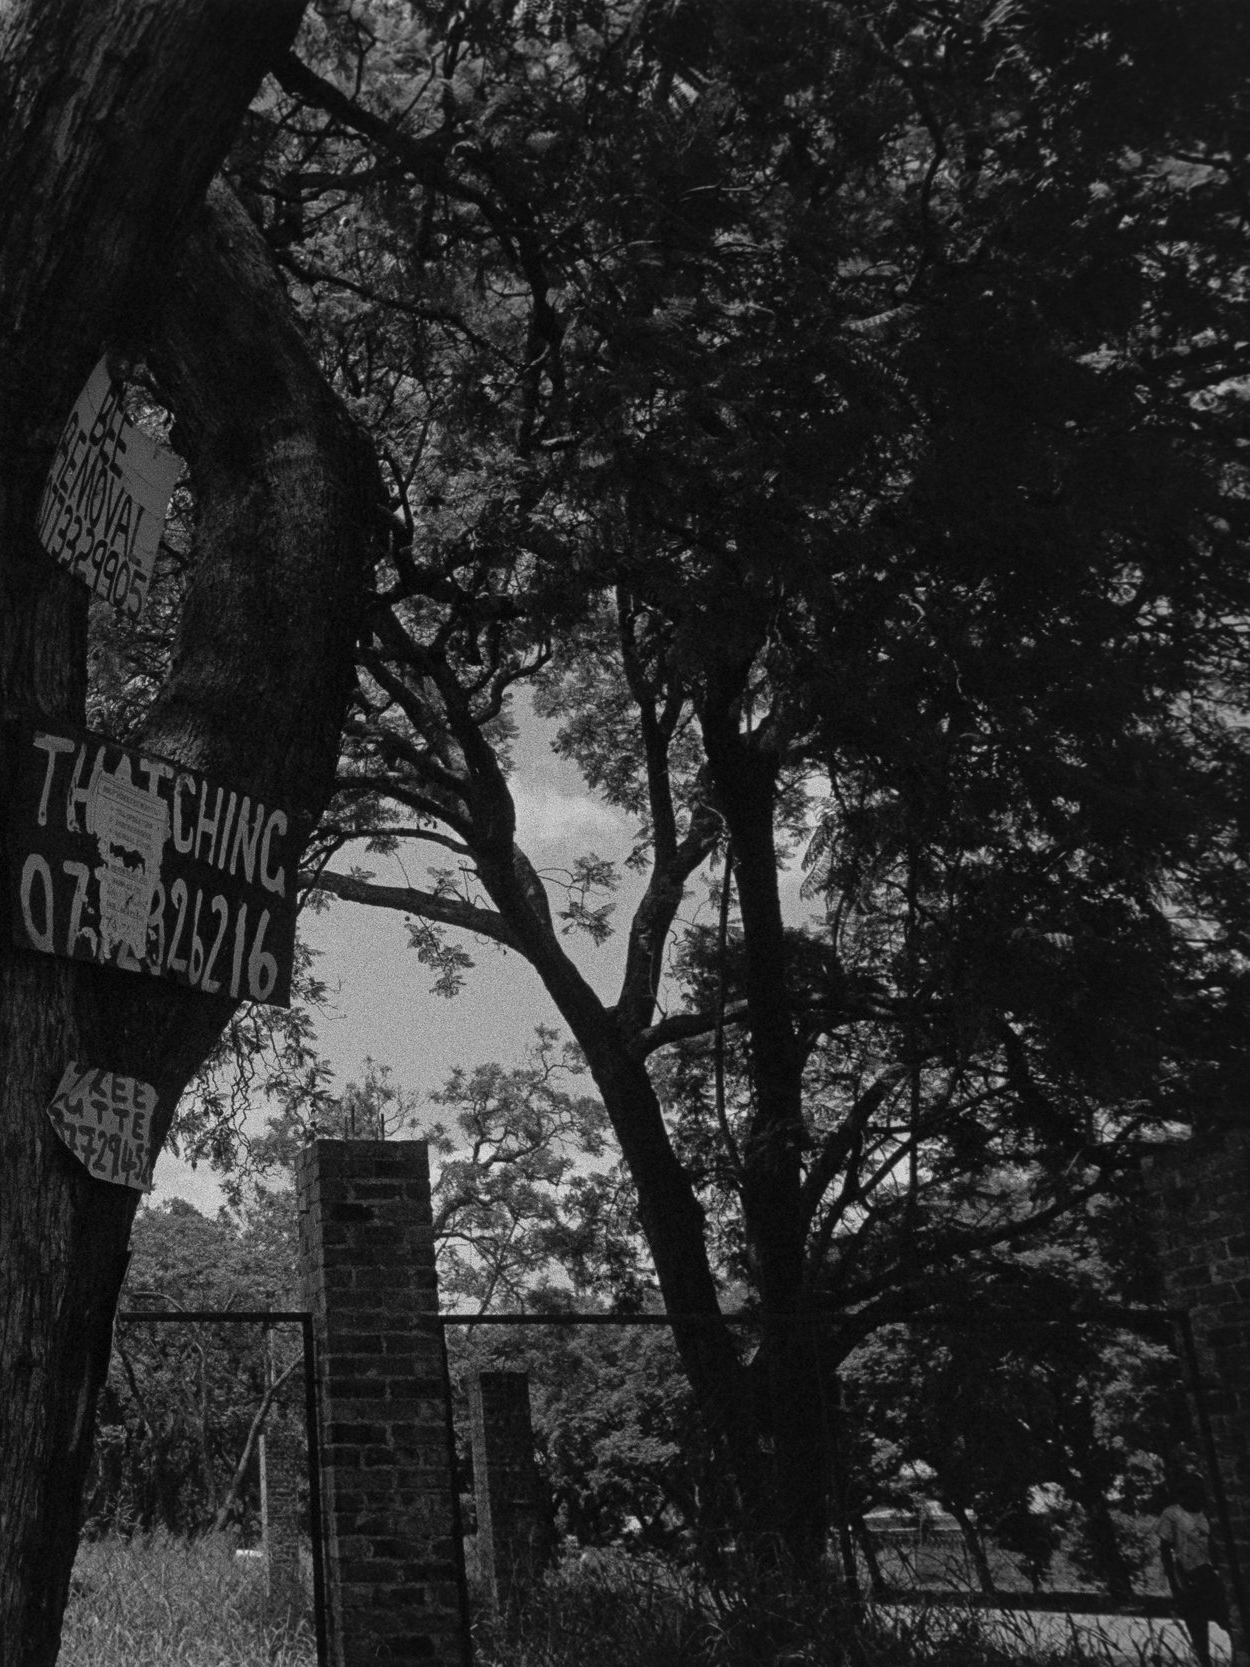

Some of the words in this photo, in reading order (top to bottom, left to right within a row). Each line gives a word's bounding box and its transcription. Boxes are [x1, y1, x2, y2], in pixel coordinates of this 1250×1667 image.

[55, 411, 145, 567] REMOVAL
[33, 731, 287, 898] THTCHING
[20, 853, 278, 1001] 0726216
